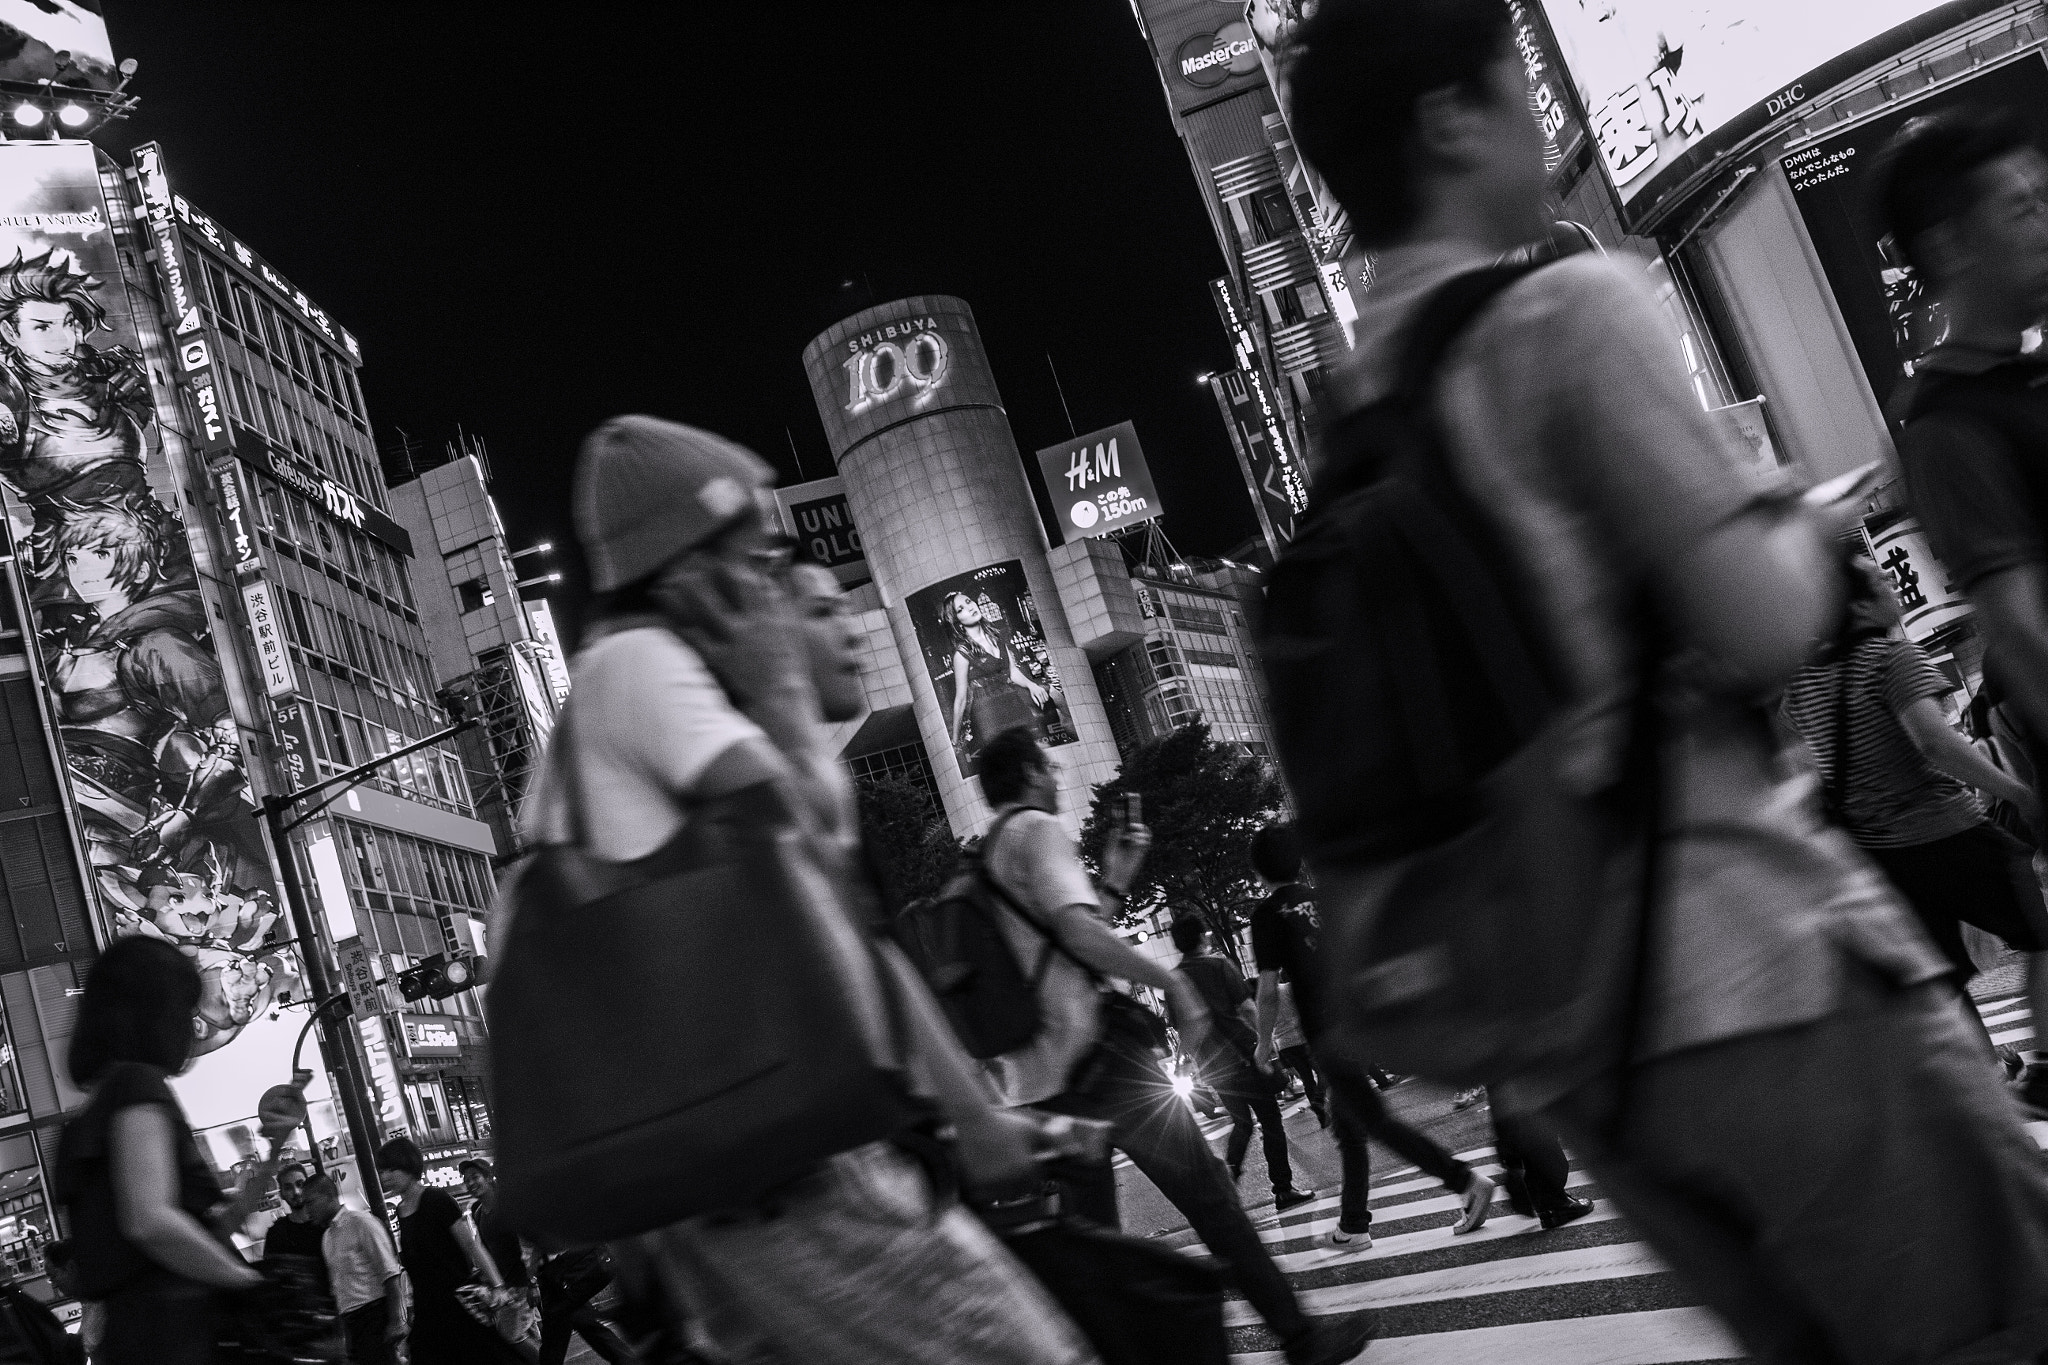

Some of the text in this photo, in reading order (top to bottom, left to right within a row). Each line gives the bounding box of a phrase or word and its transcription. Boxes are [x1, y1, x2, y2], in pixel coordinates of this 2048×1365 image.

[1182, 38, 1258, 76] MasterCar
[1765, 83, 1806, 117] DHC
[1784, 147, 1821, 169] DMMは
[1789, 147, 1856, 179] なんでこんなもの
[1794, 164, 1849, 191] つくったんだ。
[848, 317, 938, 353] SHIBUYA
[842, 330, 949, 411] 109
[197, 385, 223, 441] ガスト
[1064, 437, 1122, 492] H&M
[322, 478, 366, 529] ガスト
[1097, 486, 1131, 505] この先
[1101, 497, 1147, 521] 150m
[801, 502, 854, 533] UNI
[243, 560, 255, 572] 6F
[250, 592, 285, 687] 渋谷駅前ビル
[277, 706, 299, 724] 5F
[350, 949, 378, 1013] 渋谷駅前
